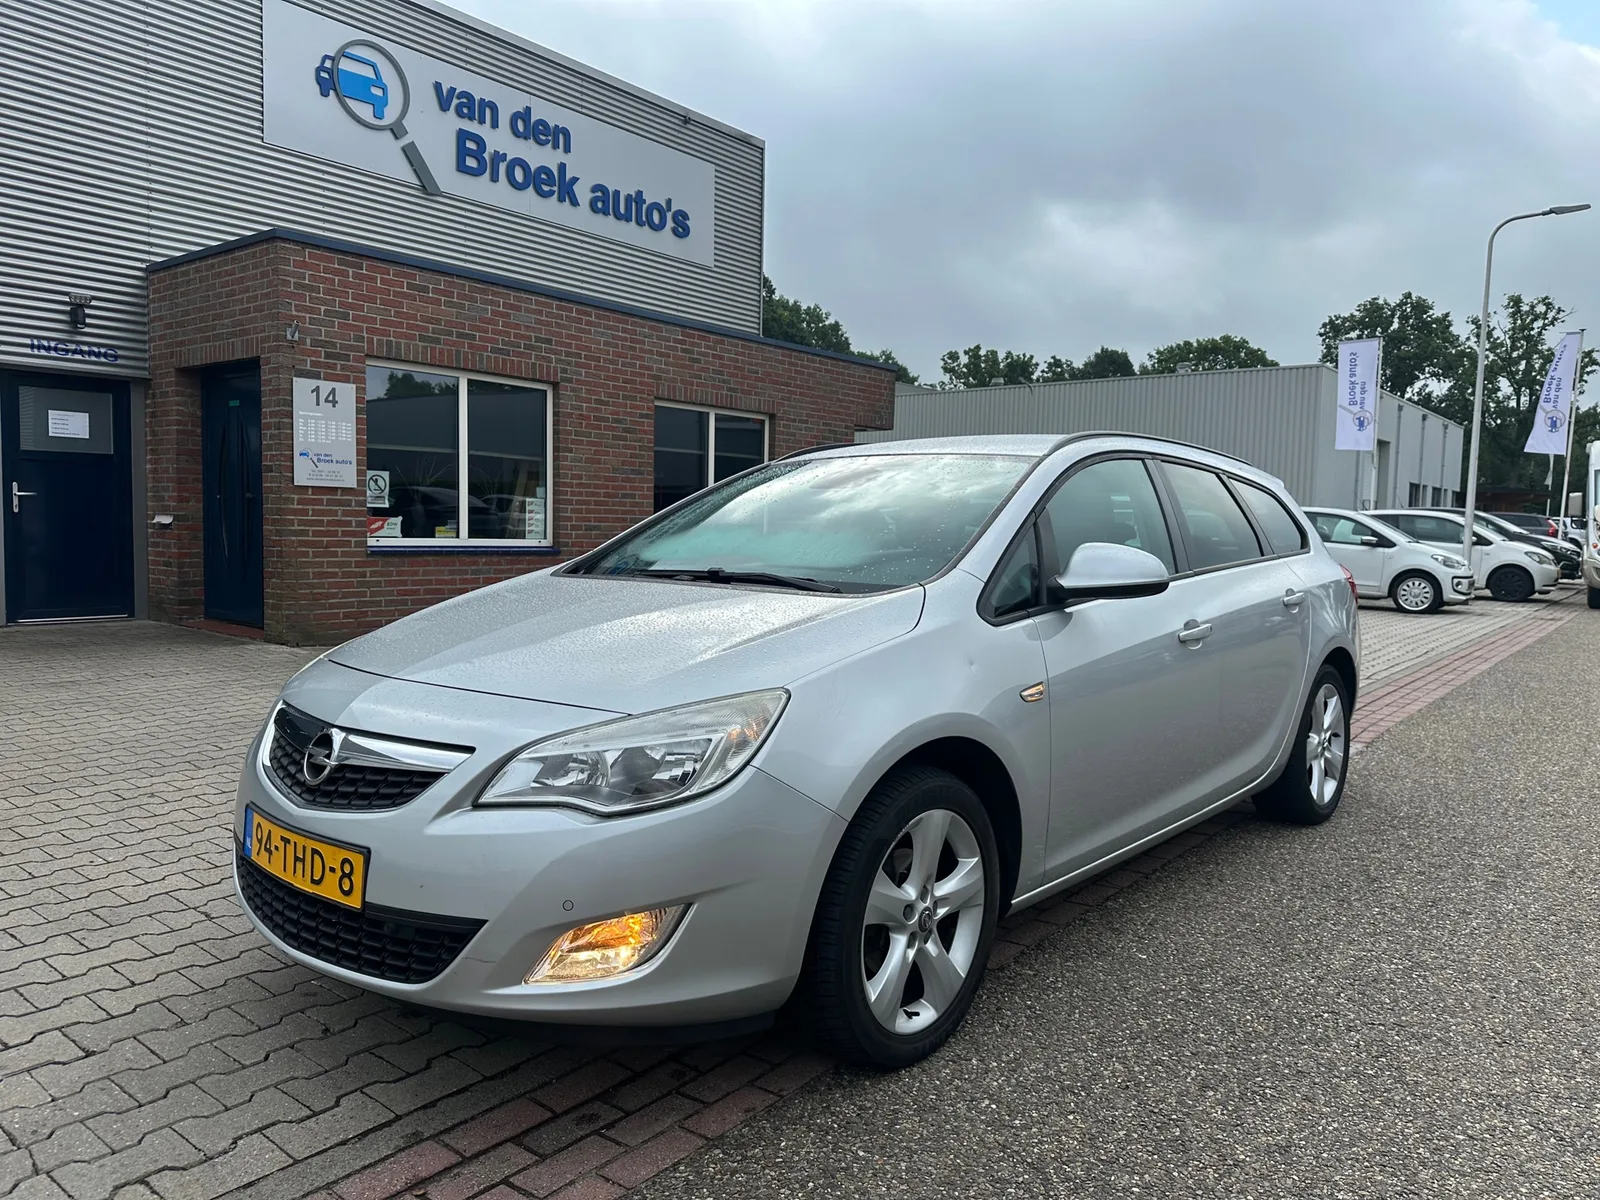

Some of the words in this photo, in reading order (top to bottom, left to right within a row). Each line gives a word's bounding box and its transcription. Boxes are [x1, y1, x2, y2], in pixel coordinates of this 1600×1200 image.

[434, 80, 499, 130] van
[510, 105, 572, 154] den
[456, 127, 580, 207] Broek
[589, 182, 691, 239] auto's
[30, 338, 119, 362] INGANG
[311, 385, 338, 408] 14
[255, 821, 354, 897] 94-THD-8
